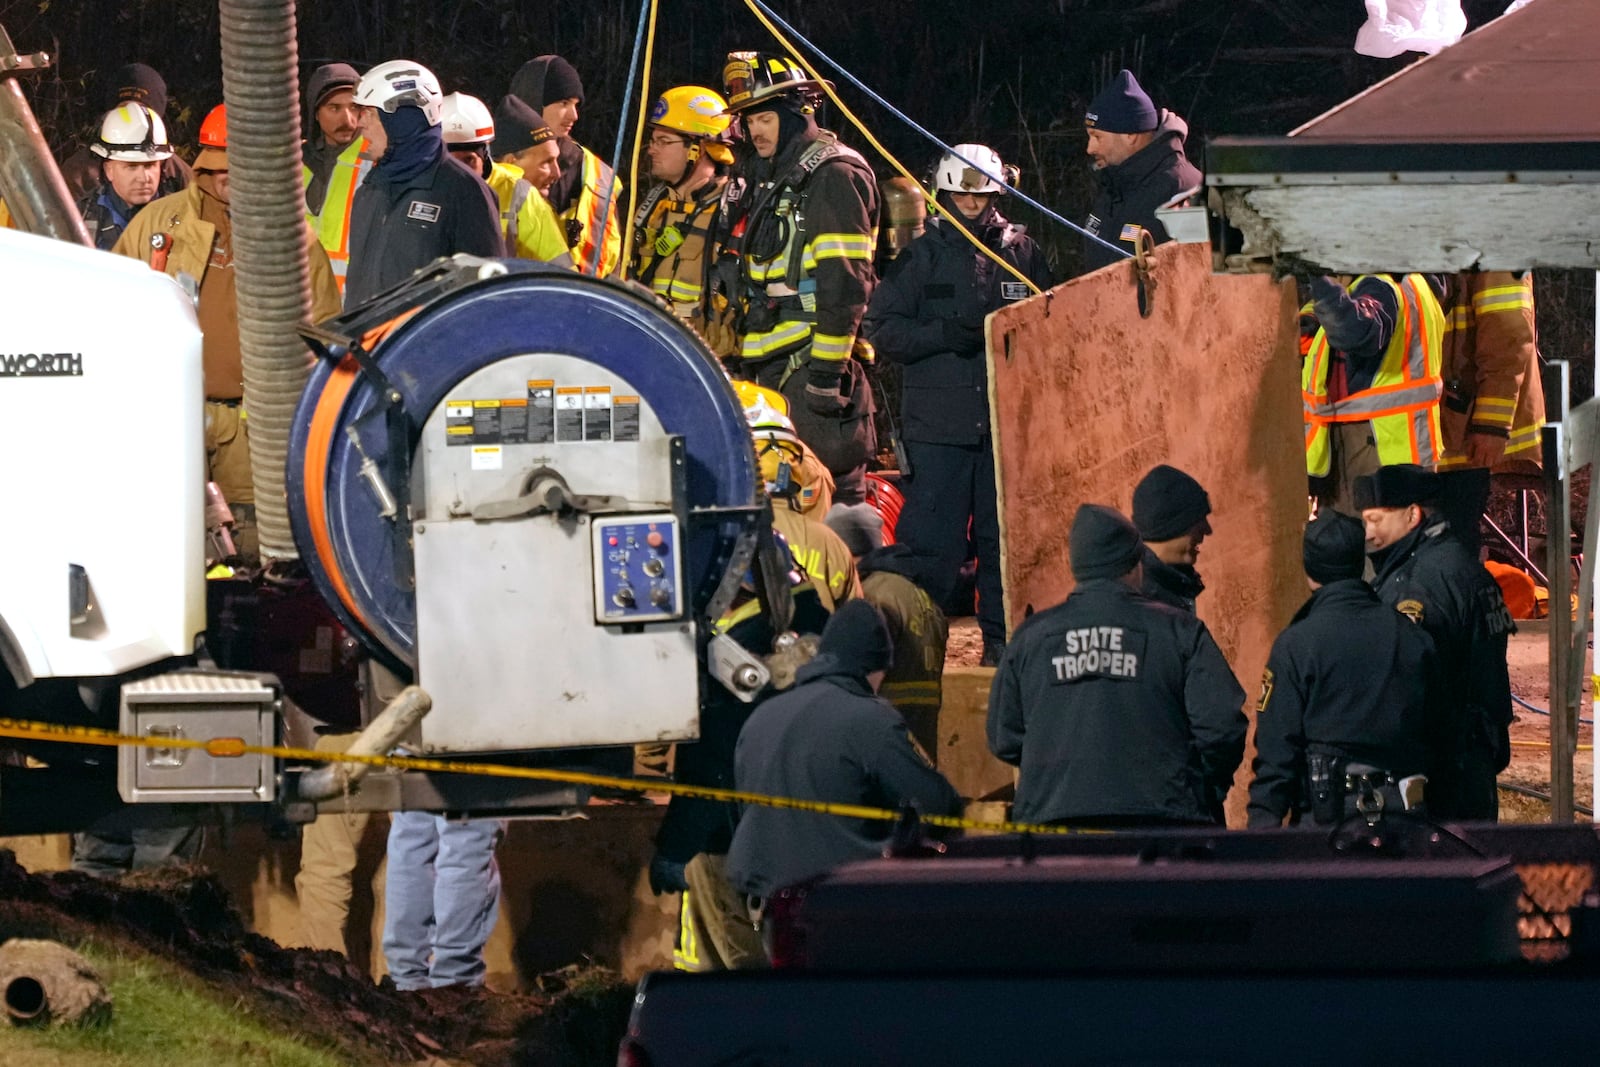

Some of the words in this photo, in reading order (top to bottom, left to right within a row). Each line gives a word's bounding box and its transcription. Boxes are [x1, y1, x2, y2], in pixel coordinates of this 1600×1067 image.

[808, 144, 839, 170] MSA
[1065, 626, 1123, 654] STATE
[1051, 649, 1137, 680] TROOPER
